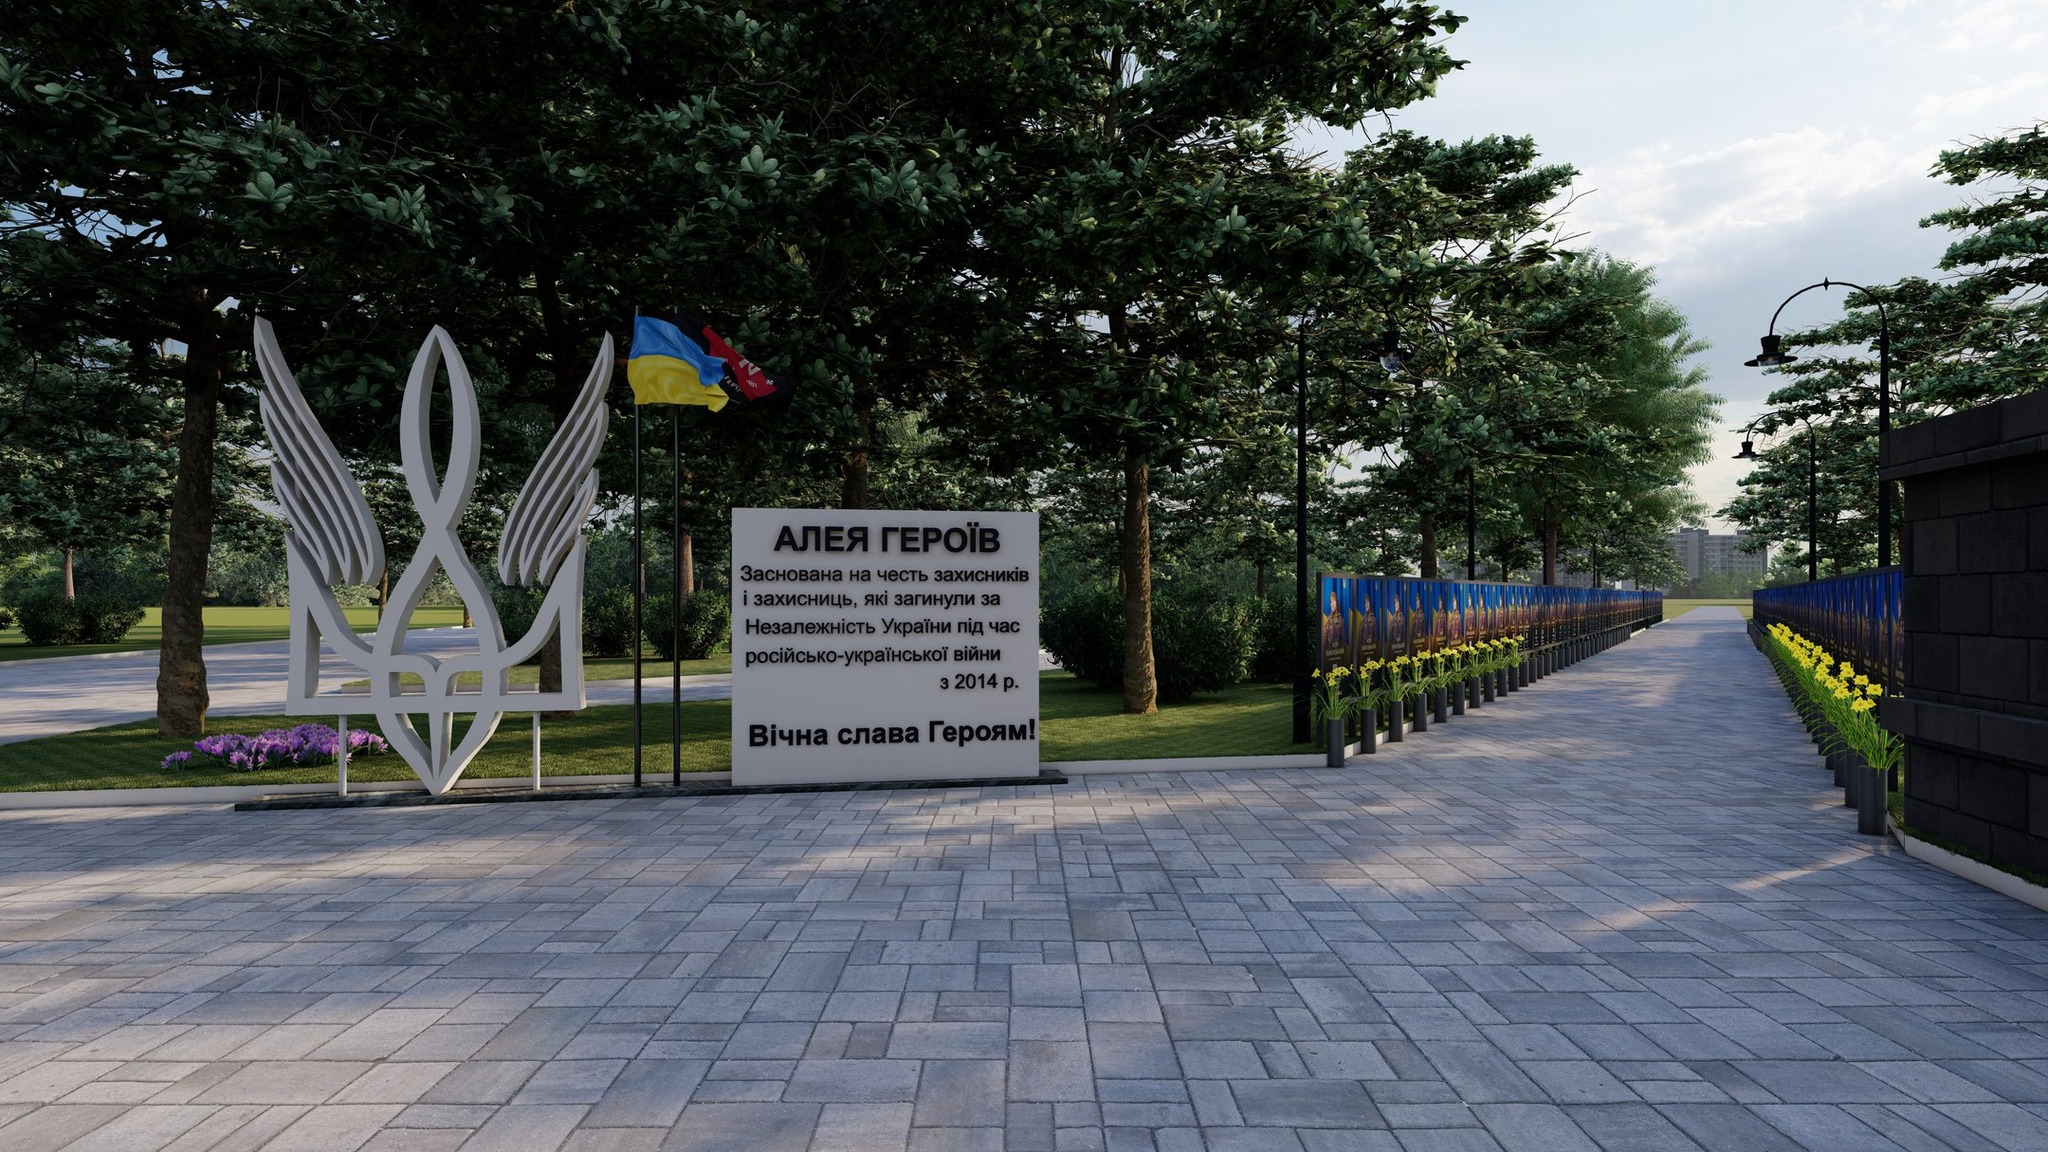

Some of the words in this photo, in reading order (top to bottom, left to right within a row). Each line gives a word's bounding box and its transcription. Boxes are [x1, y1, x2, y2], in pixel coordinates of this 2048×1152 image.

[774, 525, 869, 553] АЛЕЯ
[881, 521, 1001, 554] ГЕРОЇВ
[740, 564, 843, 582] Заснована
[849, 569, 872, 582] на
[877, 569, 929, 582] честь
[934, 566, 1030, 583] захисників
[743, 589, 748, 607] і
[753, 593, 858, 609] захисниць,
[863, 590, 889, 607] які
[893, 593, 976, 610] загинули
[980, 593, 1001, 607] за
[745, 618, 876, 635] Незалежність
[881, 617, 952, 638] України
[957, 617, 985, 637] під
[988, 621, 1021, 634] час
[745, 646, 949, 668] російсько-української
[953, 645, 1001, 662] війни
[939, 677, 950, 690] з
[954, 672, 999, 690] 2014
[1003, 676, 1019, 693] р.
[748, 723, 829, 748] Вічна
[837, 726, 920, 746] слава
[928, 718, 1036, 748] Героям!
